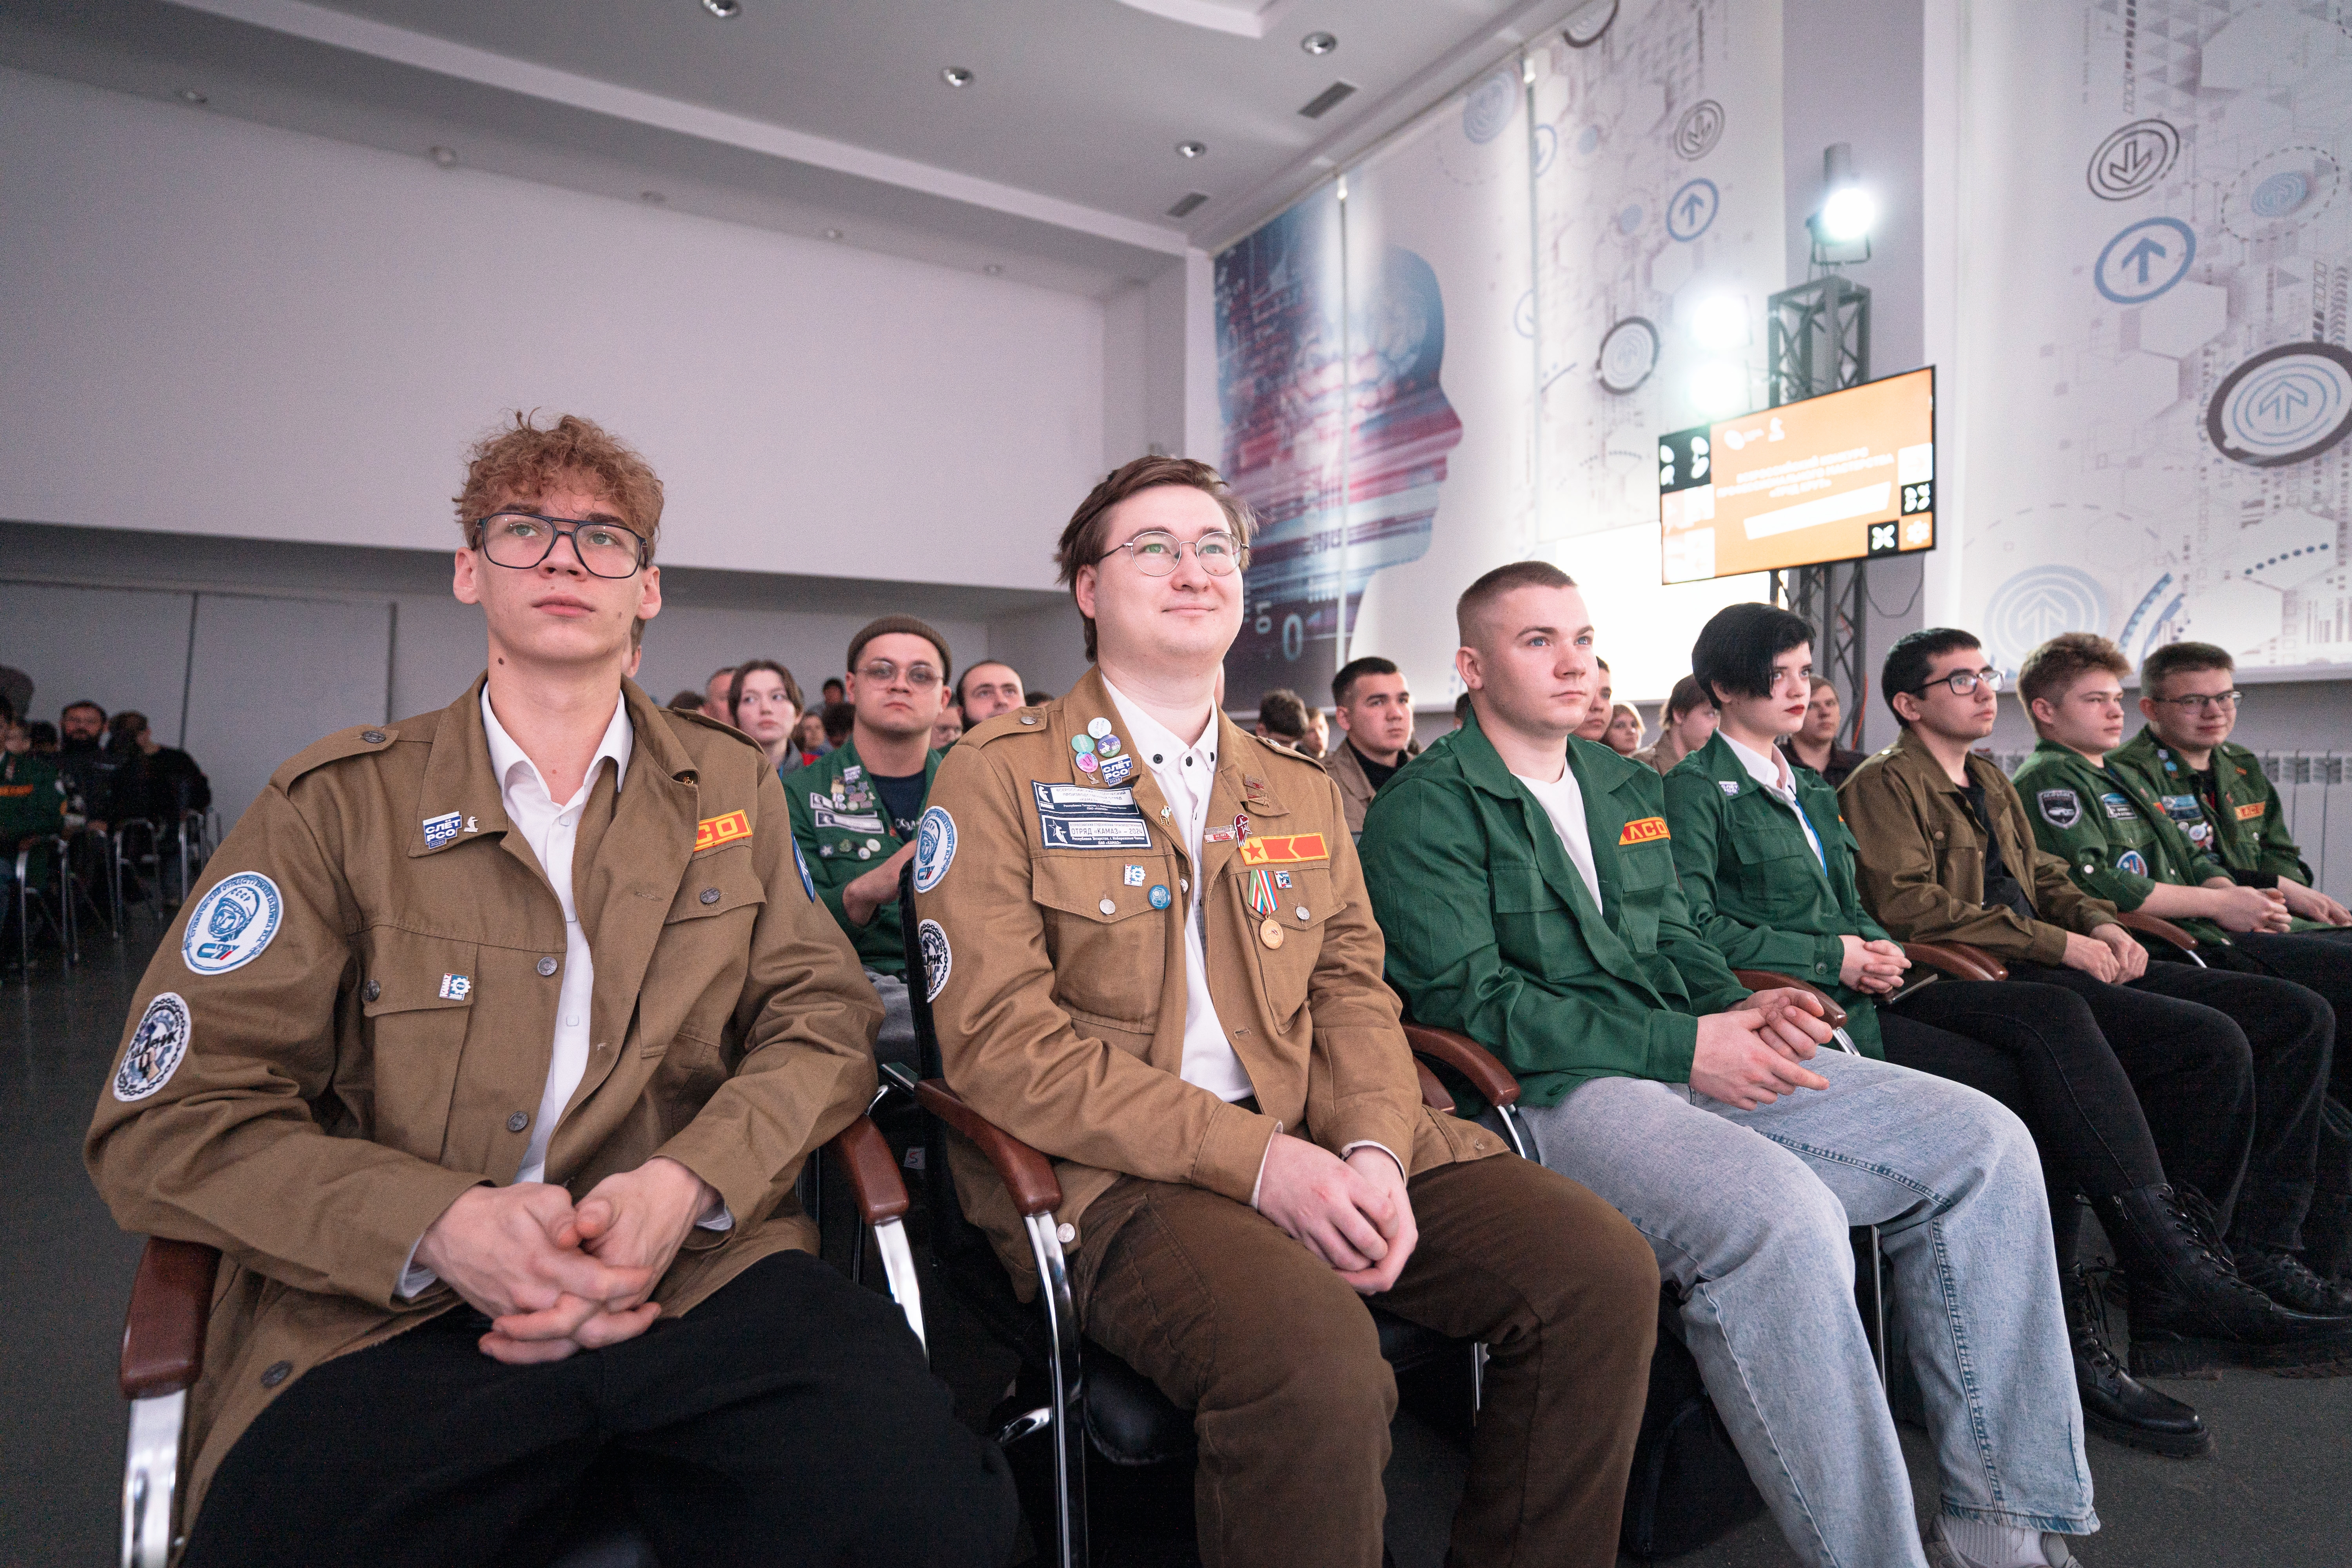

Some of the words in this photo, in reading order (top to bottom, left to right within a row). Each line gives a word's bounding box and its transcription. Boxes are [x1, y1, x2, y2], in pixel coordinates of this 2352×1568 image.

[1103, 760, 1131, 773] СЛЁТ
[1105, 768, 1128, 780] РСО
[425, 819, 460, 833] СЛЁТ
[427, 829, 455, 842] РСО
